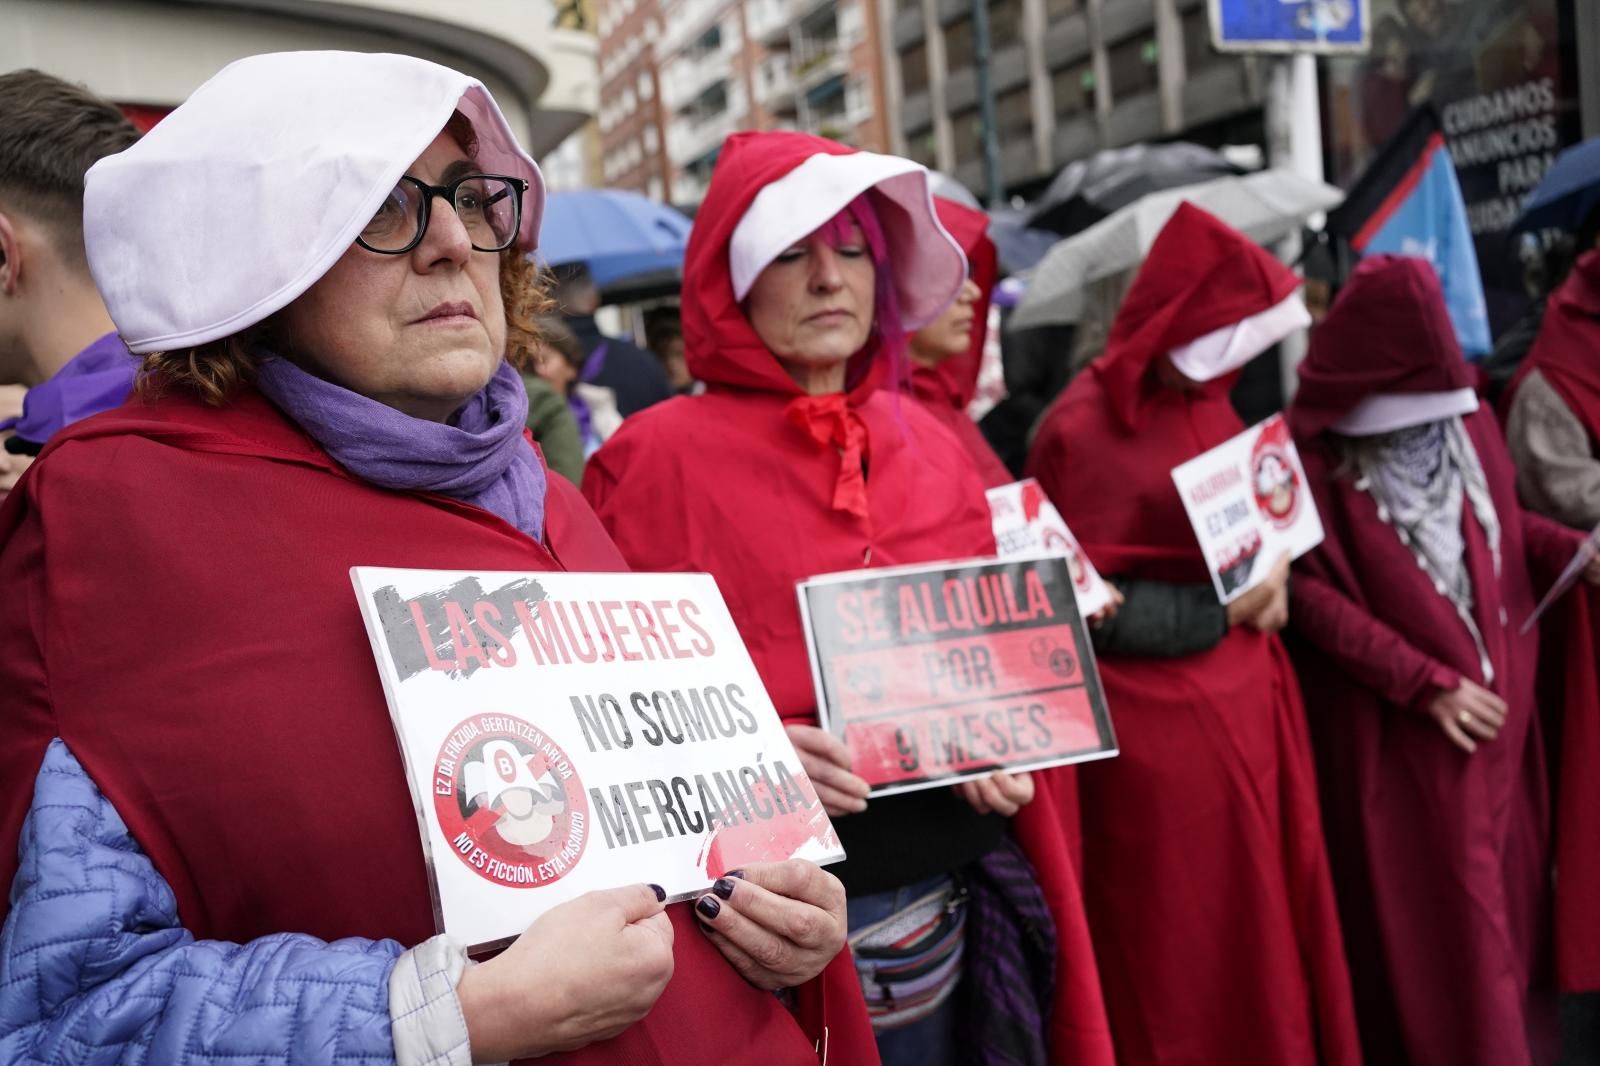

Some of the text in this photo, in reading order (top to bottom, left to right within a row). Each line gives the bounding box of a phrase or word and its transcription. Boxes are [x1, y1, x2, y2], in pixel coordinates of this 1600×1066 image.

[1443, 77, 1555, 136] CUIDAMOS
[410, 598, 716, 671] LAS MUJERES
[836, 568, 1054, 643] SE ALQUILA
[922, 645, 997, 697] POR
[481, 717, 544, 747] GERTATZEN
[569, 683, 759, 753] NO SOMOS
[895, 703, 1053, 772] 9 MESES
[438, 758, 456, 778] DA
[542, 745, 560, 767] ARI
[558, 760, 573, 780] DA
[436, 777, 453, 796] EZ
[588, 751, 811, 850] MERCANCÍA
[453, 831, 475, 855] NO
[468, 848, 489, 868] ES
[486, 858, 538, 884] FICCIÓN,
[560, 811, 584, 865] PASANDO
